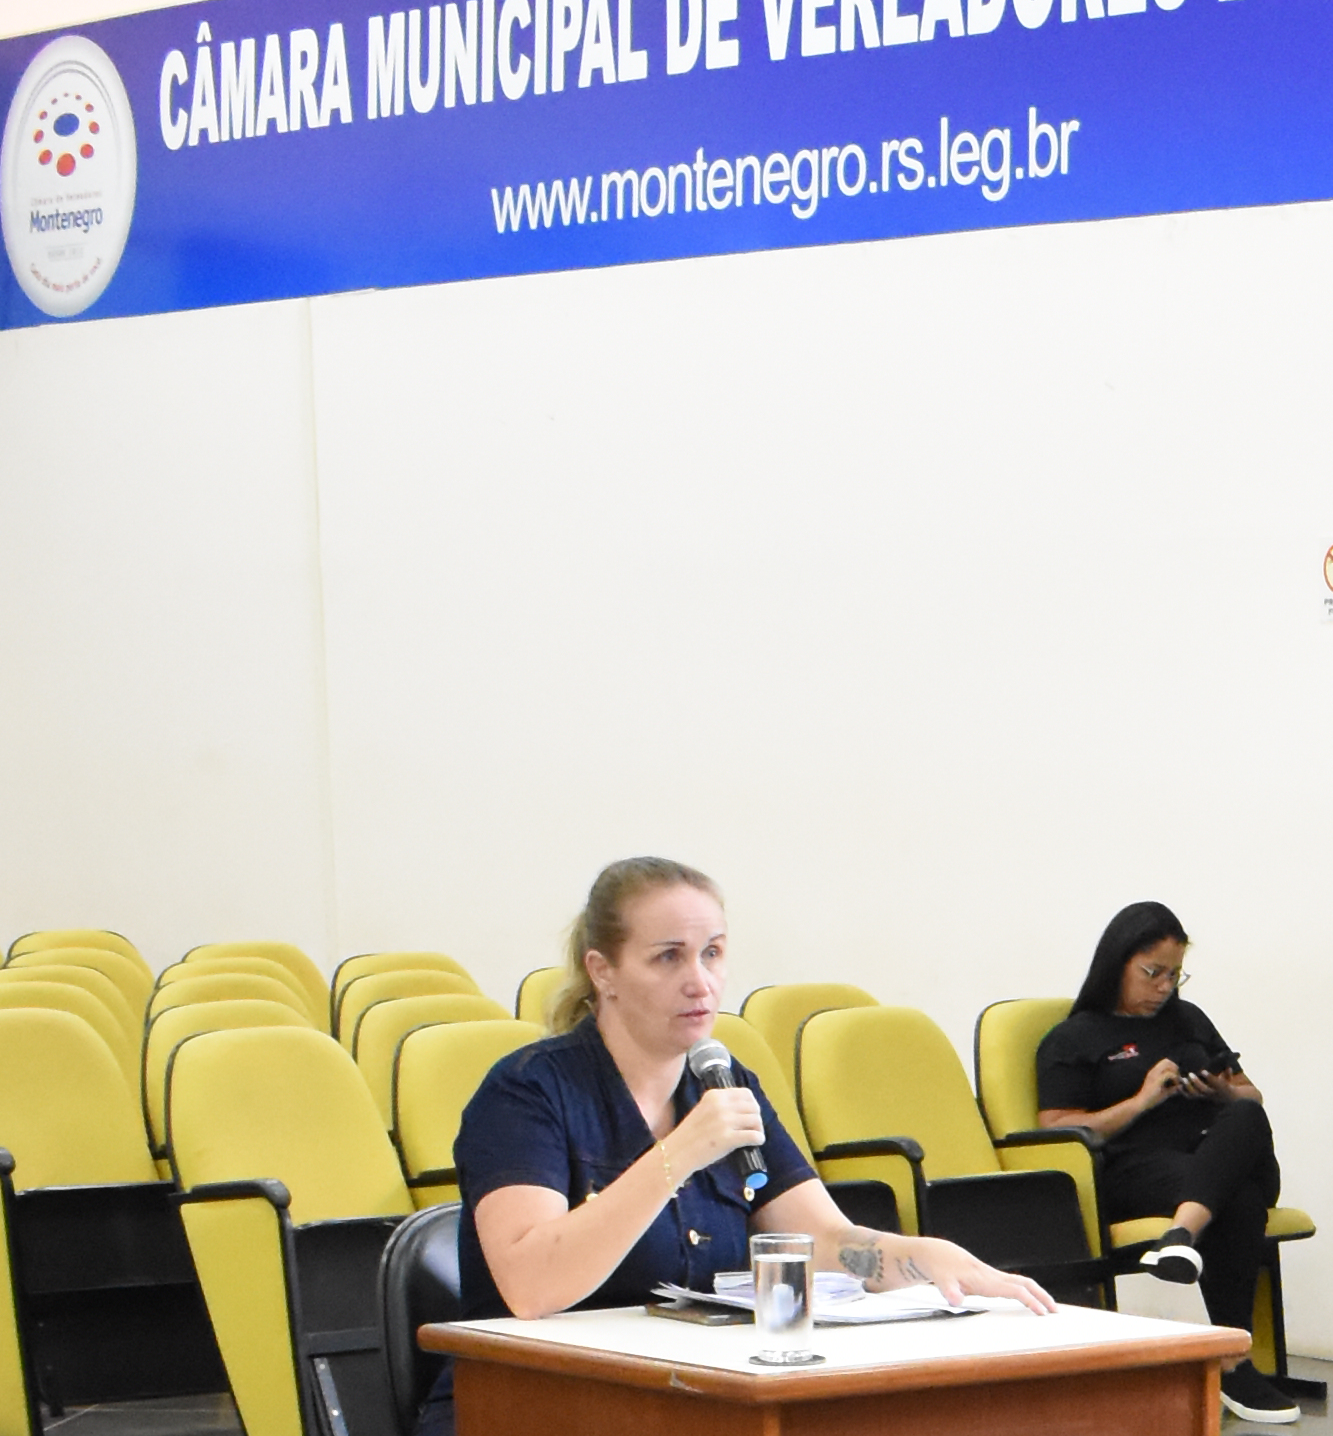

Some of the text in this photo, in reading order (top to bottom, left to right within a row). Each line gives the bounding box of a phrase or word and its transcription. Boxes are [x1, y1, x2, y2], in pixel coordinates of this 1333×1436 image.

[158, 20, 353, 151] CÂMARA
[366, 0, 649, 120] MUNICIPAL
[666, 0, 740, 76] DE
[30, 208, 103, 234] Montenegro
[490, 106, 1081, 234] www.montenegro.rs.leg.br
